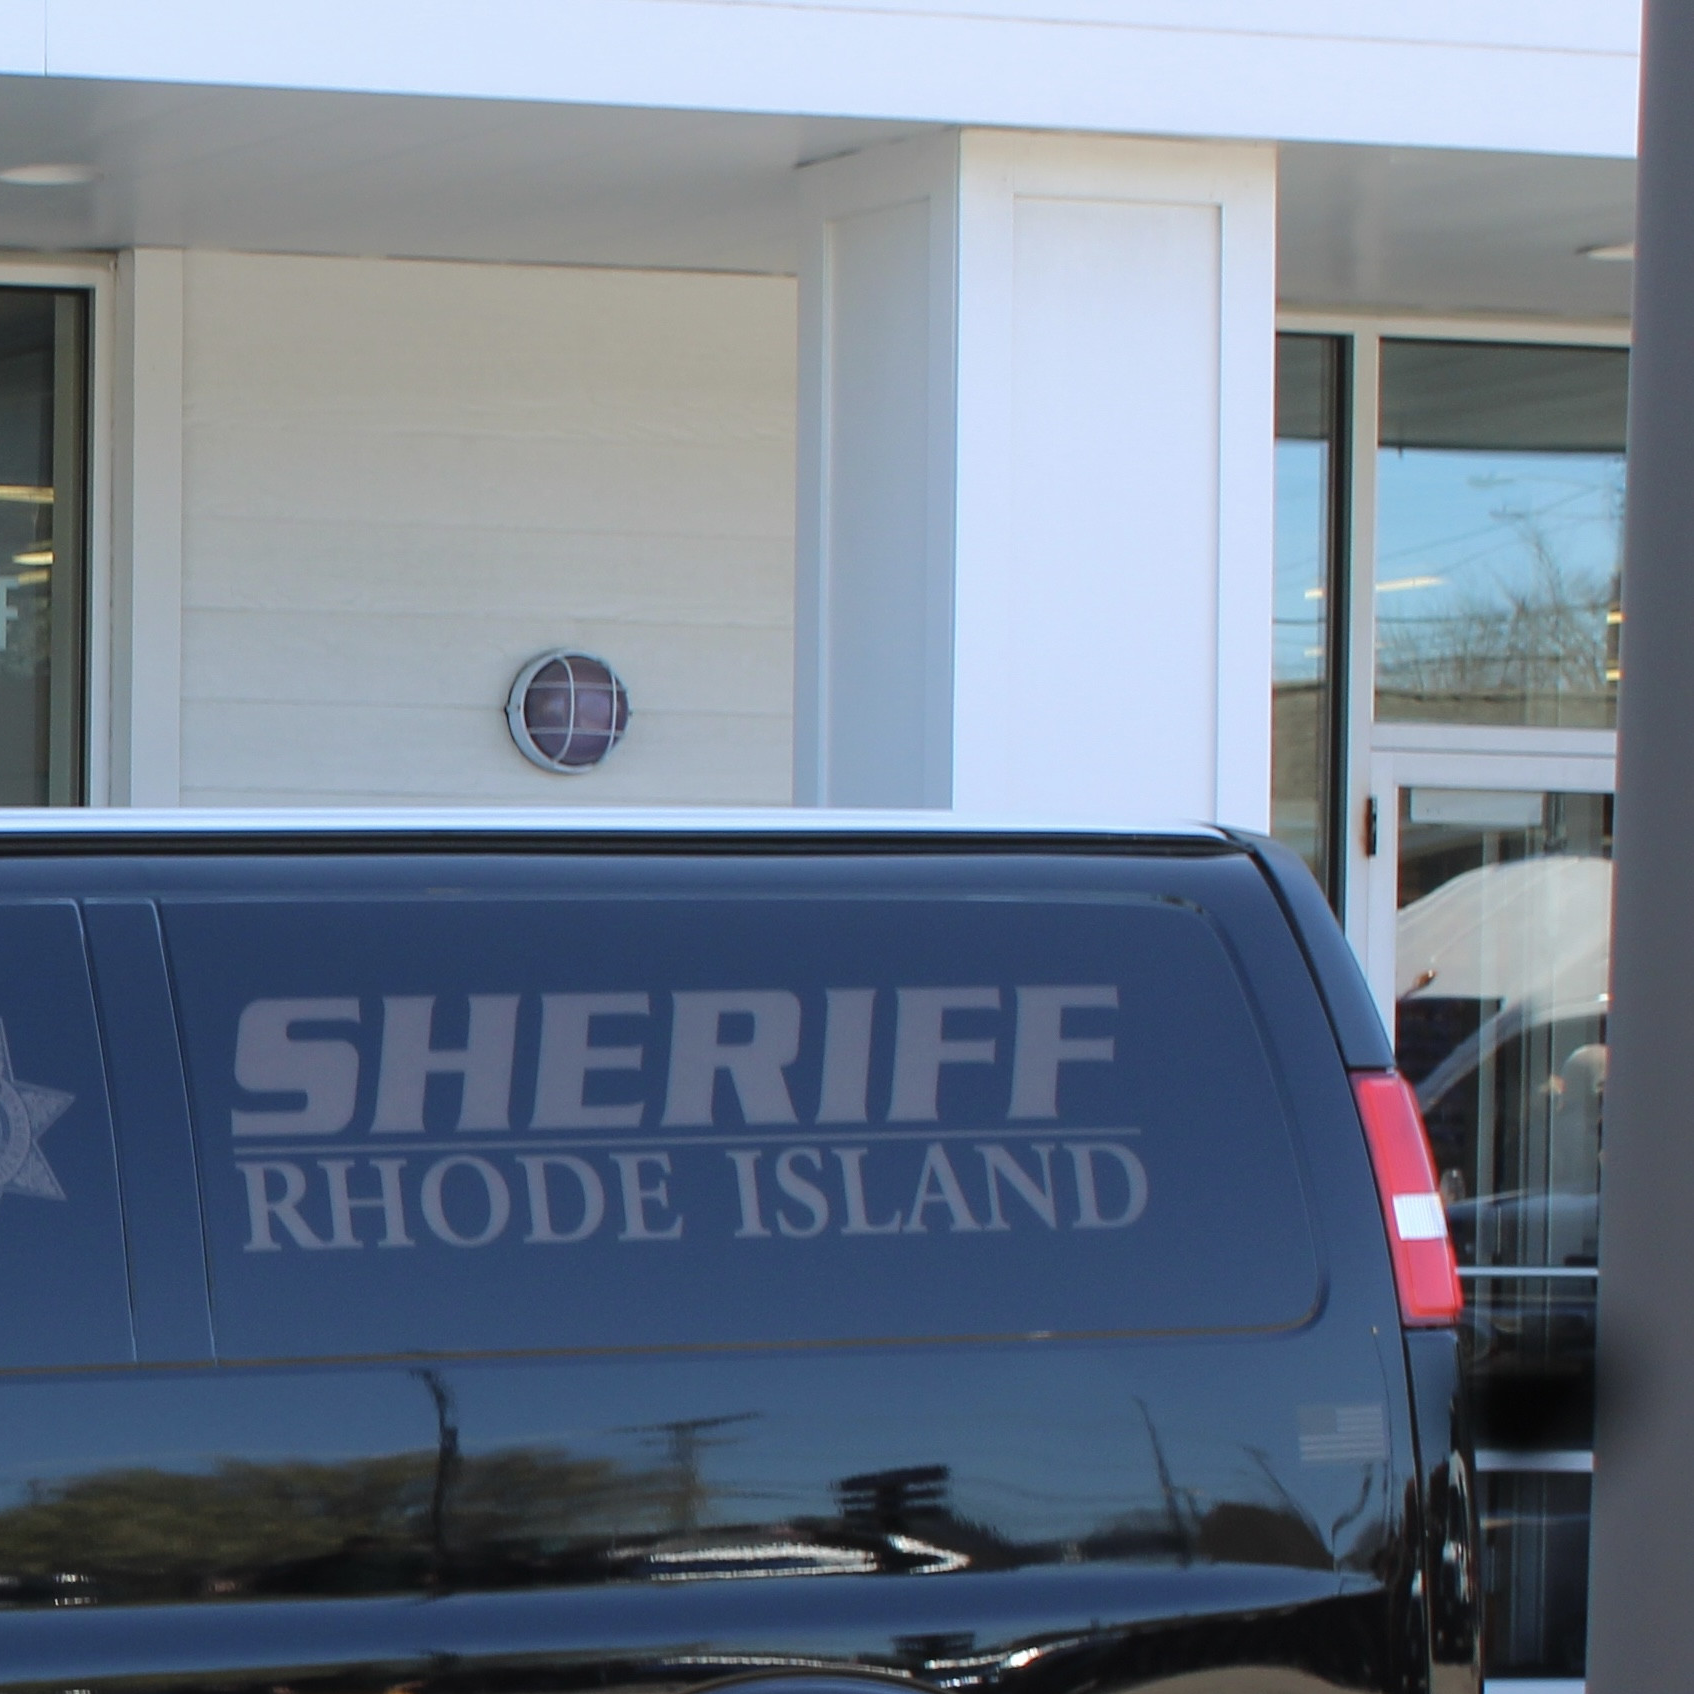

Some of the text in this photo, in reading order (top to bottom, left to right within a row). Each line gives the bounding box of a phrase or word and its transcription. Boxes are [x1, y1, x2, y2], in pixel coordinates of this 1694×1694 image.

[231, 986, 1119, 1136] SHERIFF
[234, 1141, 1148, 1252] RHODE ISLAND
